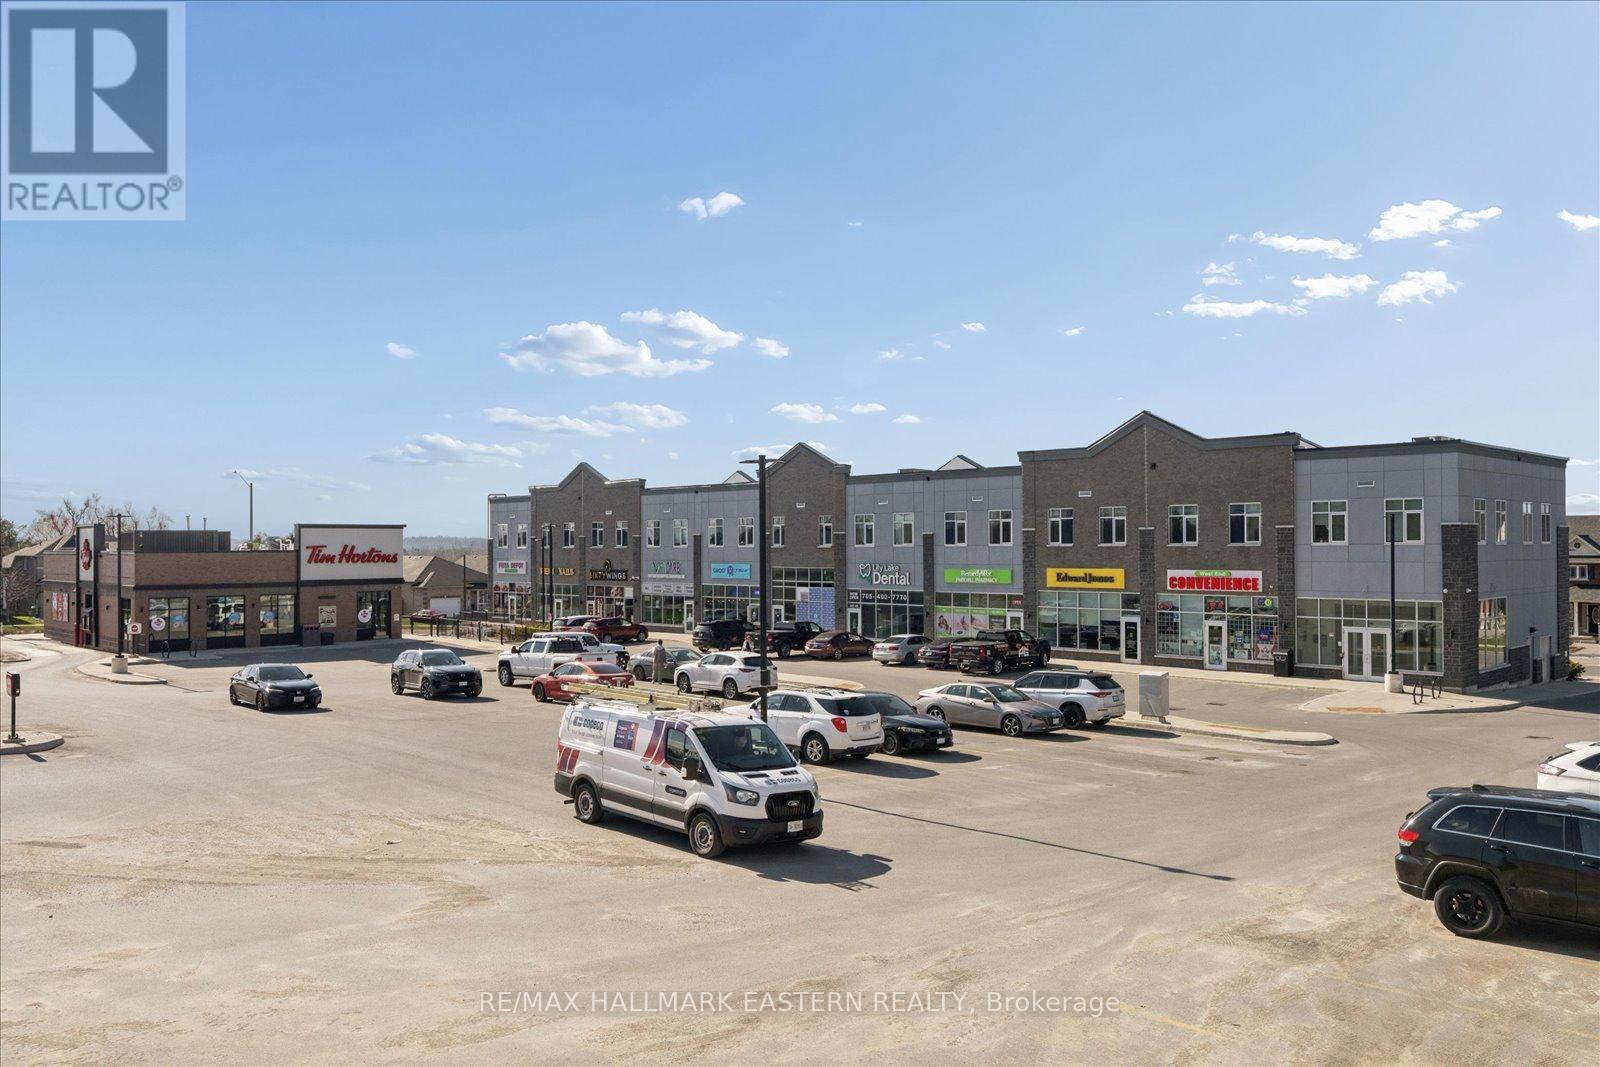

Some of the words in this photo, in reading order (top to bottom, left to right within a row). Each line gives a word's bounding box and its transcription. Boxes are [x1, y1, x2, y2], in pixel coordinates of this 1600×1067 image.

[306, 545, 336, 564] Tim
[338, 544, 398, 564] Hortons
[873, 564, 884, 573] Lily
[885, 564, 899, 572] Lake
[873, 572, 910, 585] Dental
[1169, 576, 1259, 591] CONVENIENCE
